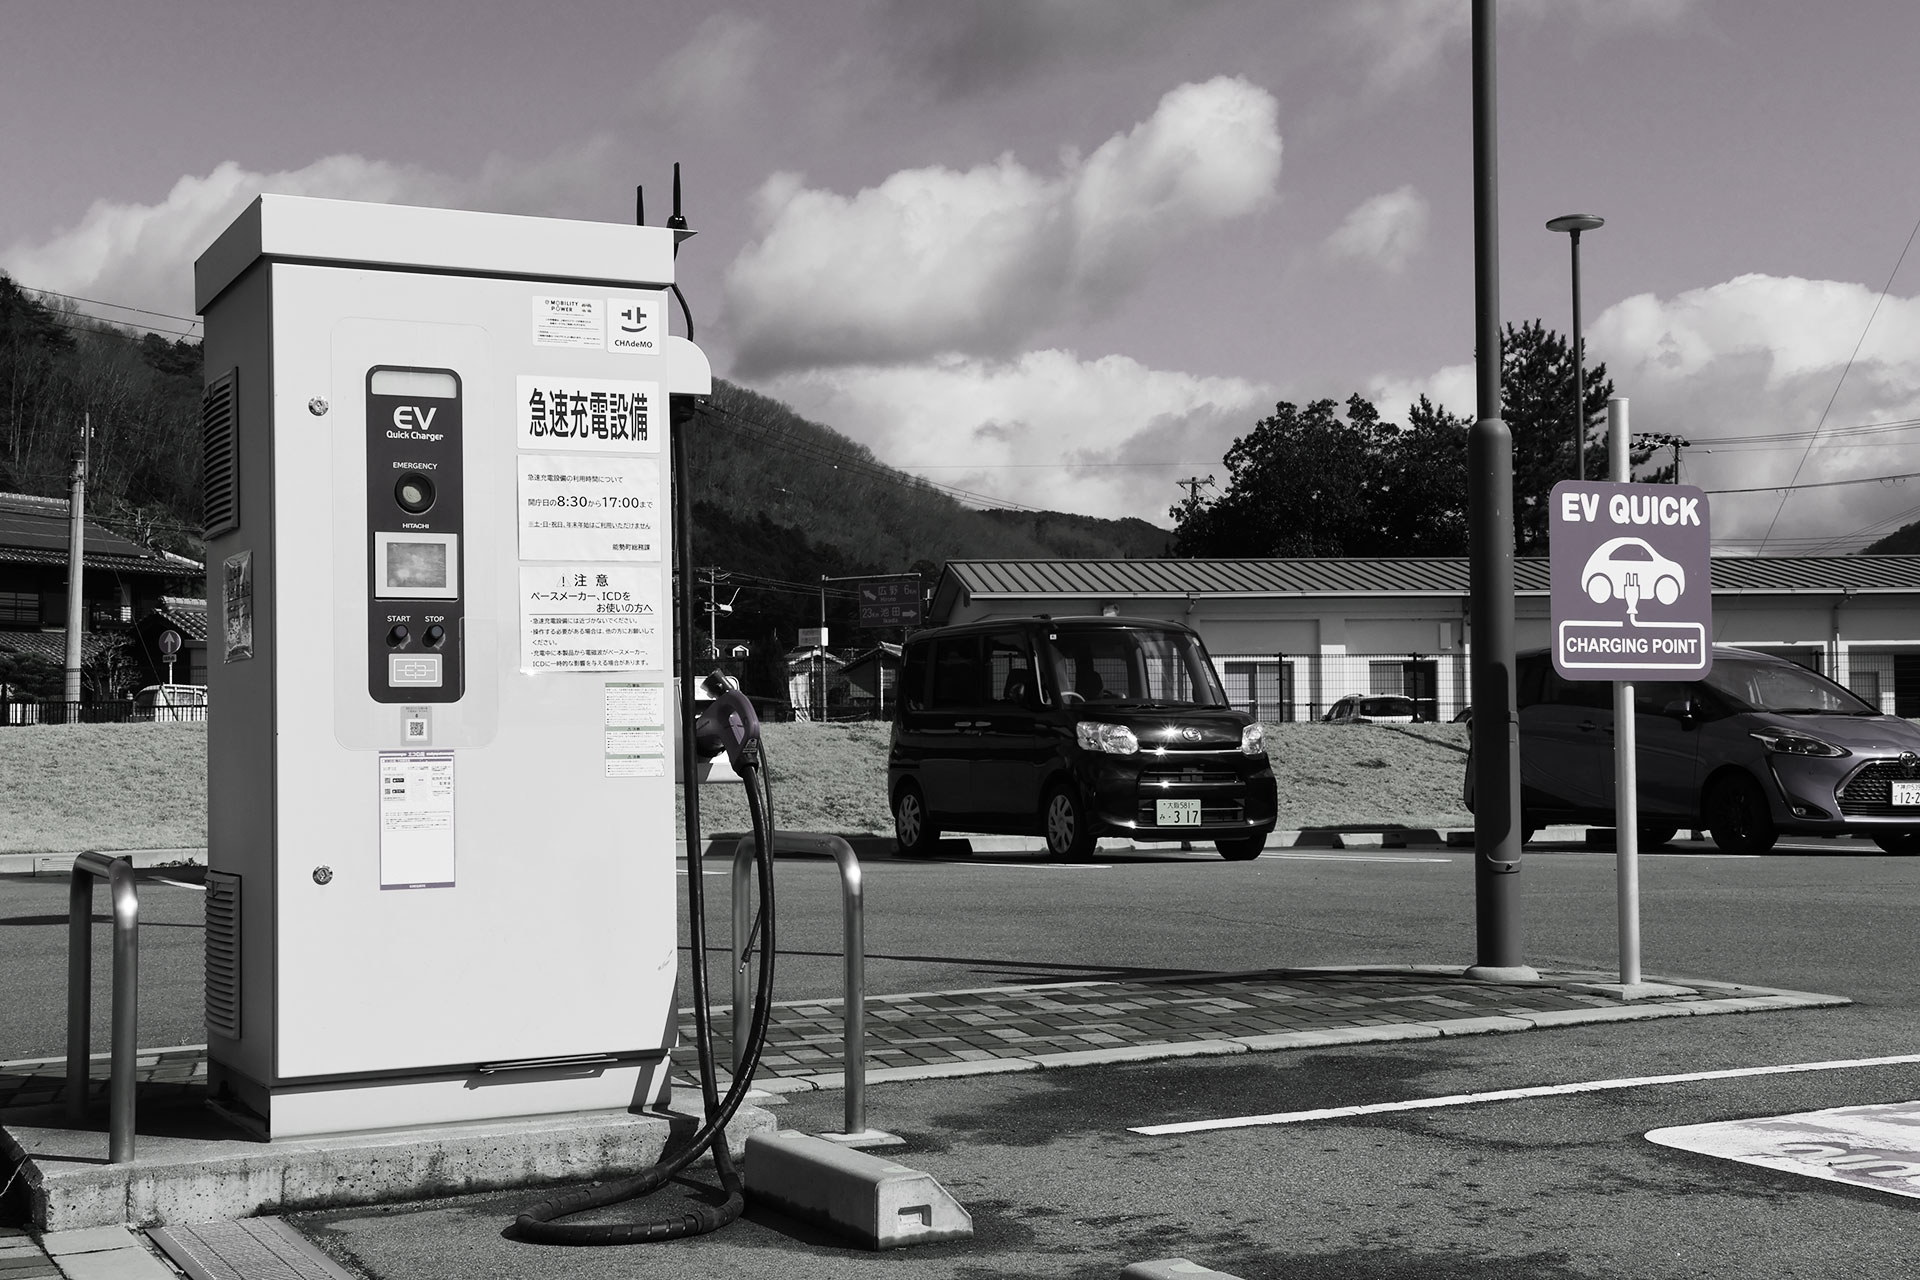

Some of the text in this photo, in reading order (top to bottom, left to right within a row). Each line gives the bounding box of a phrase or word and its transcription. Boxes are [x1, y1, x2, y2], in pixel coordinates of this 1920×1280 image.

[393, 405, 437, 431] EV
[529, 387, 648, 441] 急速充電設備
[386, 430, 444, 442] Quick Charger
[392, 461, 438, 470] EMERGENCY
[527, 474, 624, 483] 急速充電設備の利用時間について
[528, 495, 653, 509] 開庁日の8:30から17:00まで
[1561, 492, 1701, 527] EV QUICK
[596, 603, 653, 613] お使いの方へ
[424, 615, 445, 623] STOP
[1566, 637, 1698, 654] CHARGING POINT
